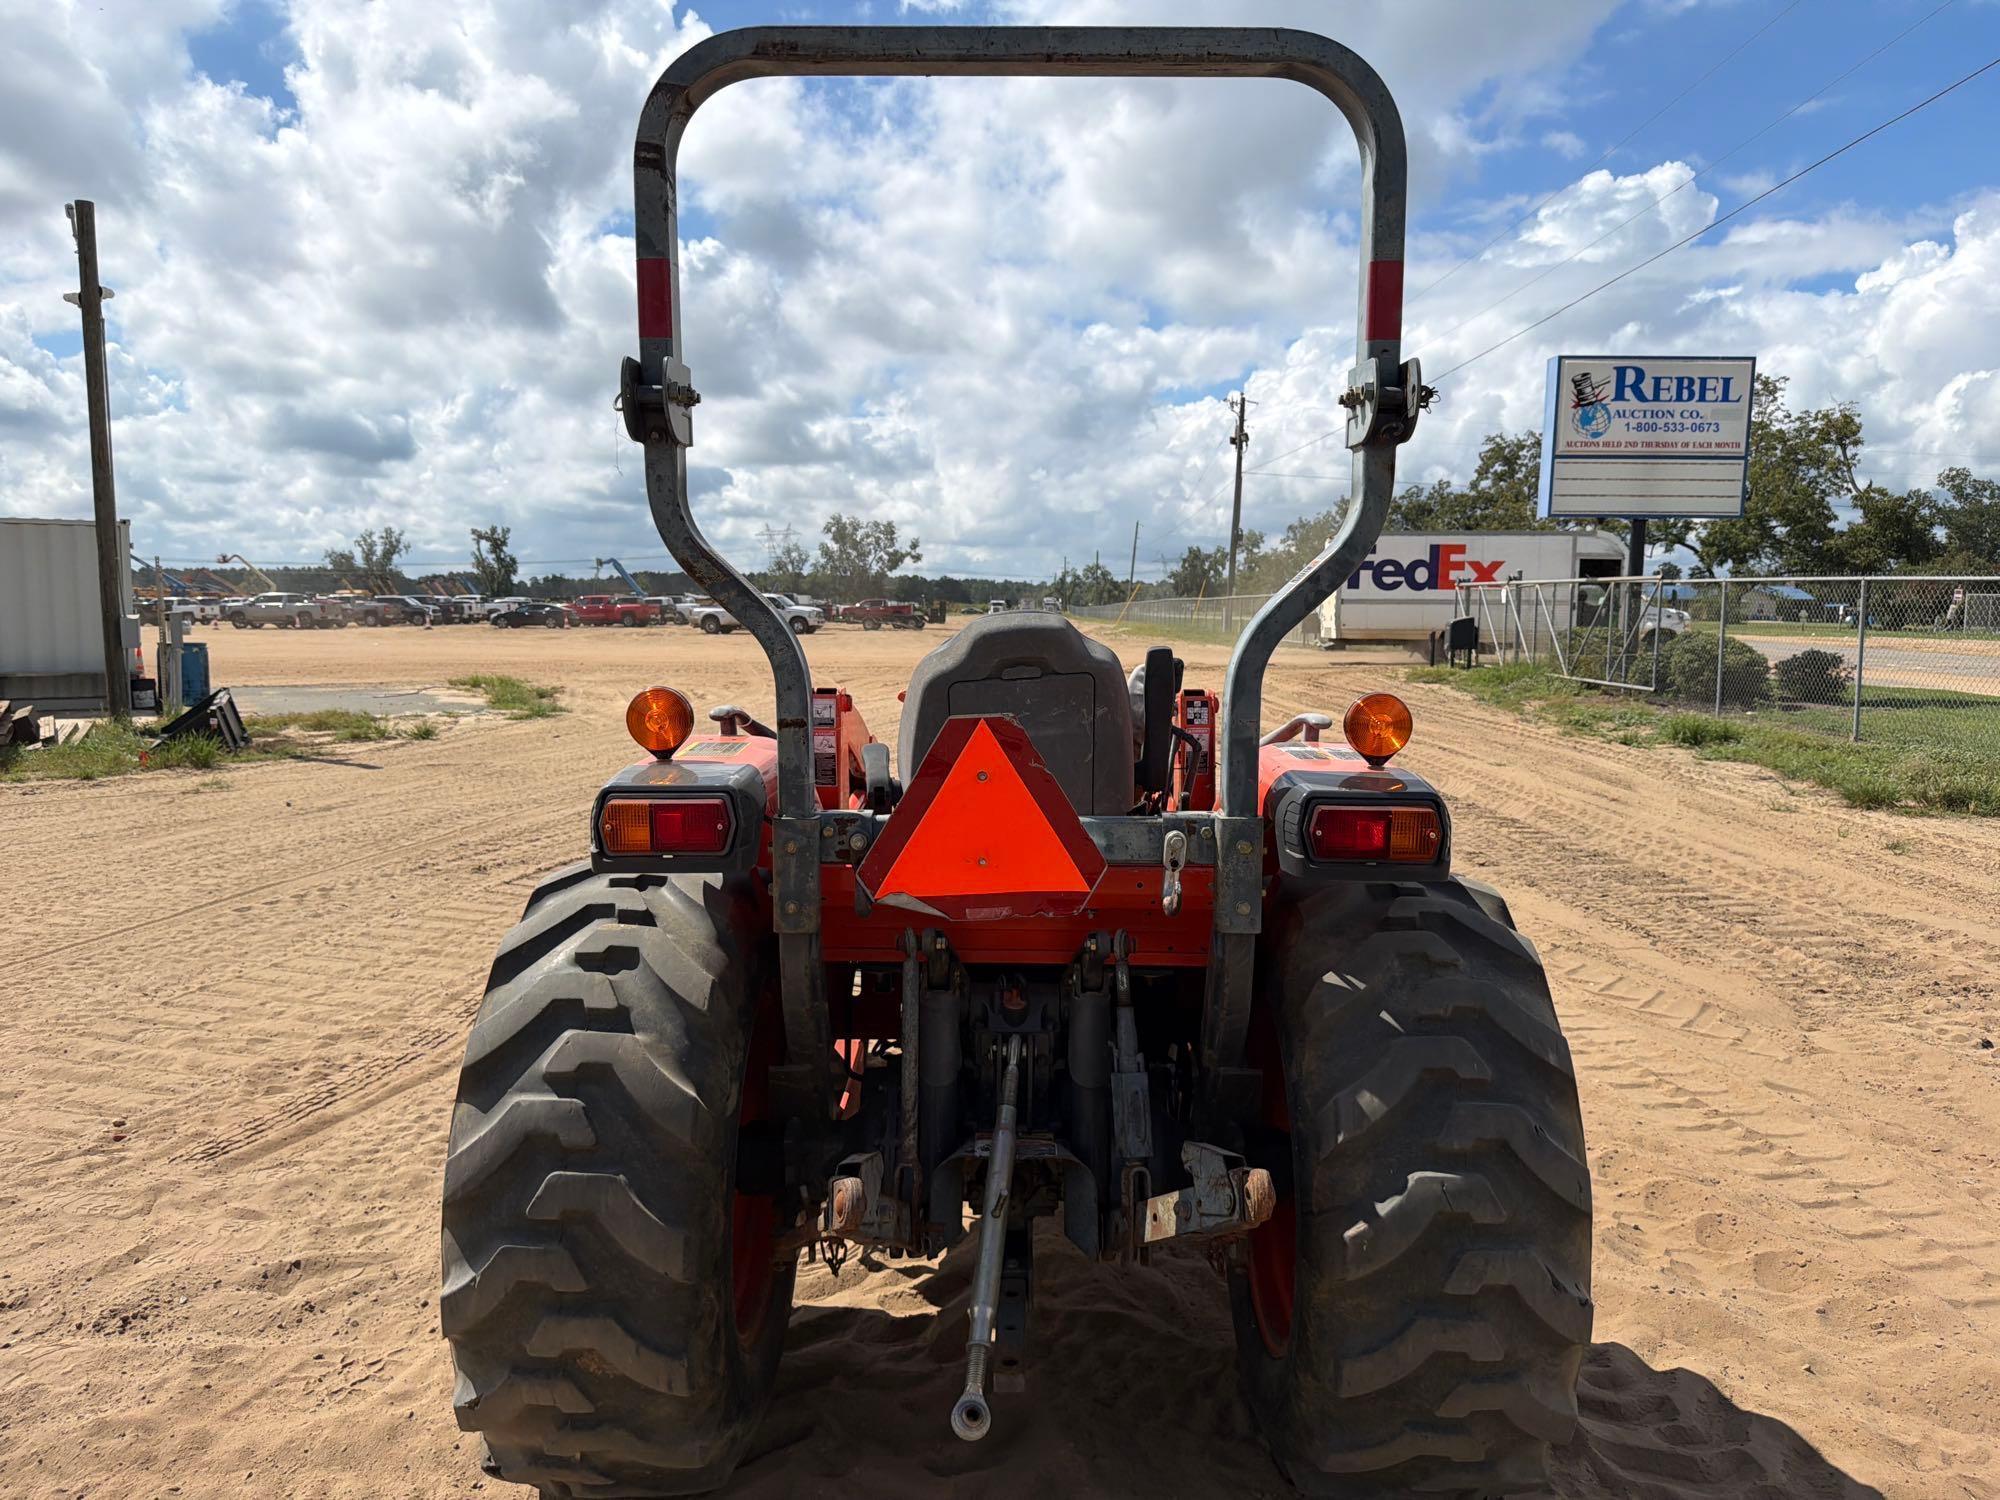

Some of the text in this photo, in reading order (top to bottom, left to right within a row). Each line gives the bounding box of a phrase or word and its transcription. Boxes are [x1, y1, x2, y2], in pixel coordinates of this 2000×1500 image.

[1612, 409, 1704, 419] AUCTION CO.
[1625, 422, 1720, 433] 1-800-533-0673
[1565, 440, 1600, 449] AUCTIONS
[1601, 440, 1623, 449] HELD
[1641, 440, 1678, 449] THURSDAY
[1680, 440, 1690, 449] OF
[1692, 440, 1713, 449] EACH
[1714, 440, 1741, 449] MONTH
